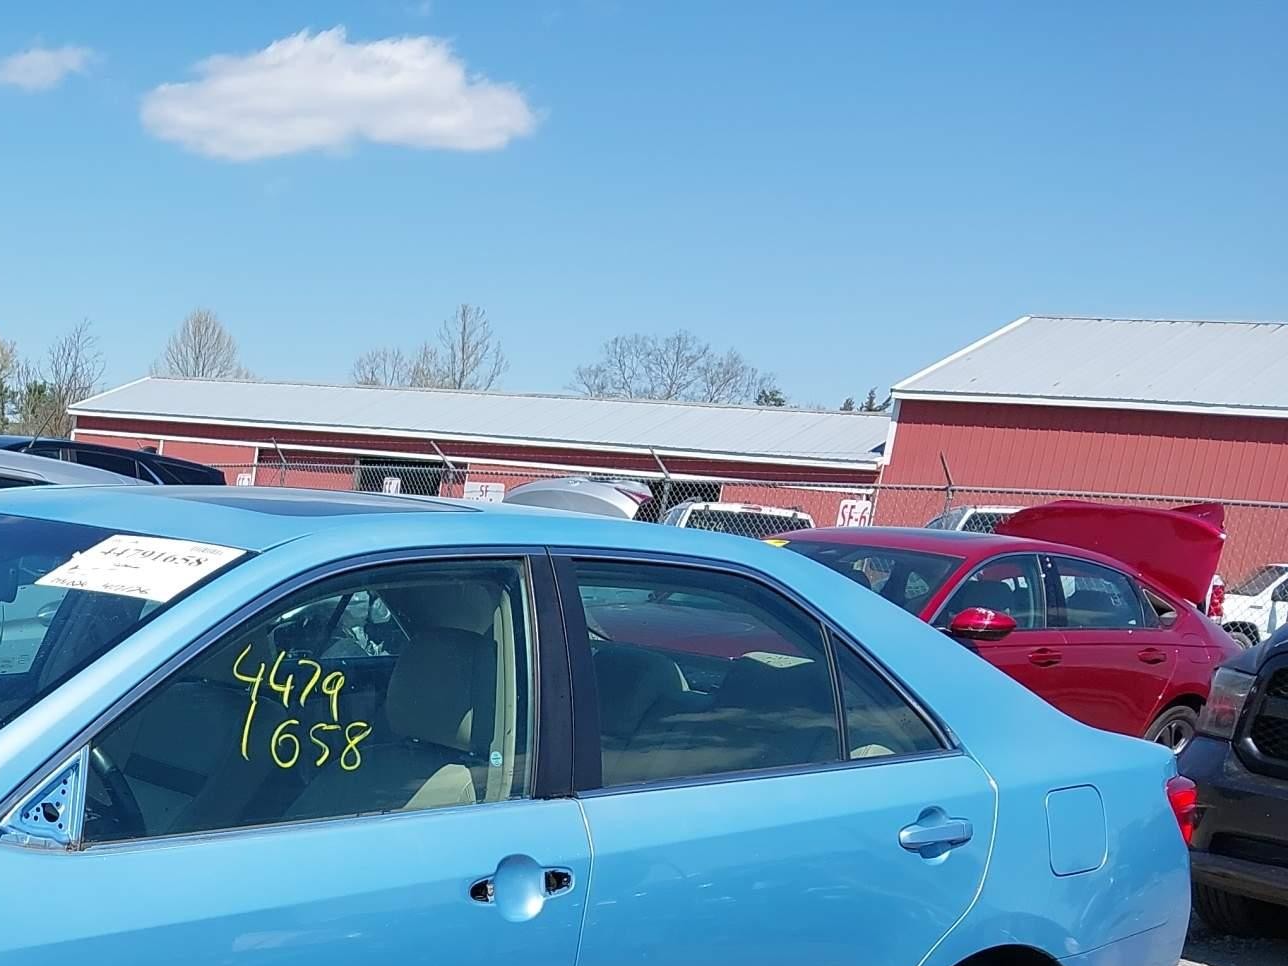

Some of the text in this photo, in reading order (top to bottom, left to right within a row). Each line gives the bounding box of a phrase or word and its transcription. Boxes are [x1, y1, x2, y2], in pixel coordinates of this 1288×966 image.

[479, 484, 489, 498] SF
[233, 643, 345, 723] 4479
[241, 699, 373, 771] 1658
